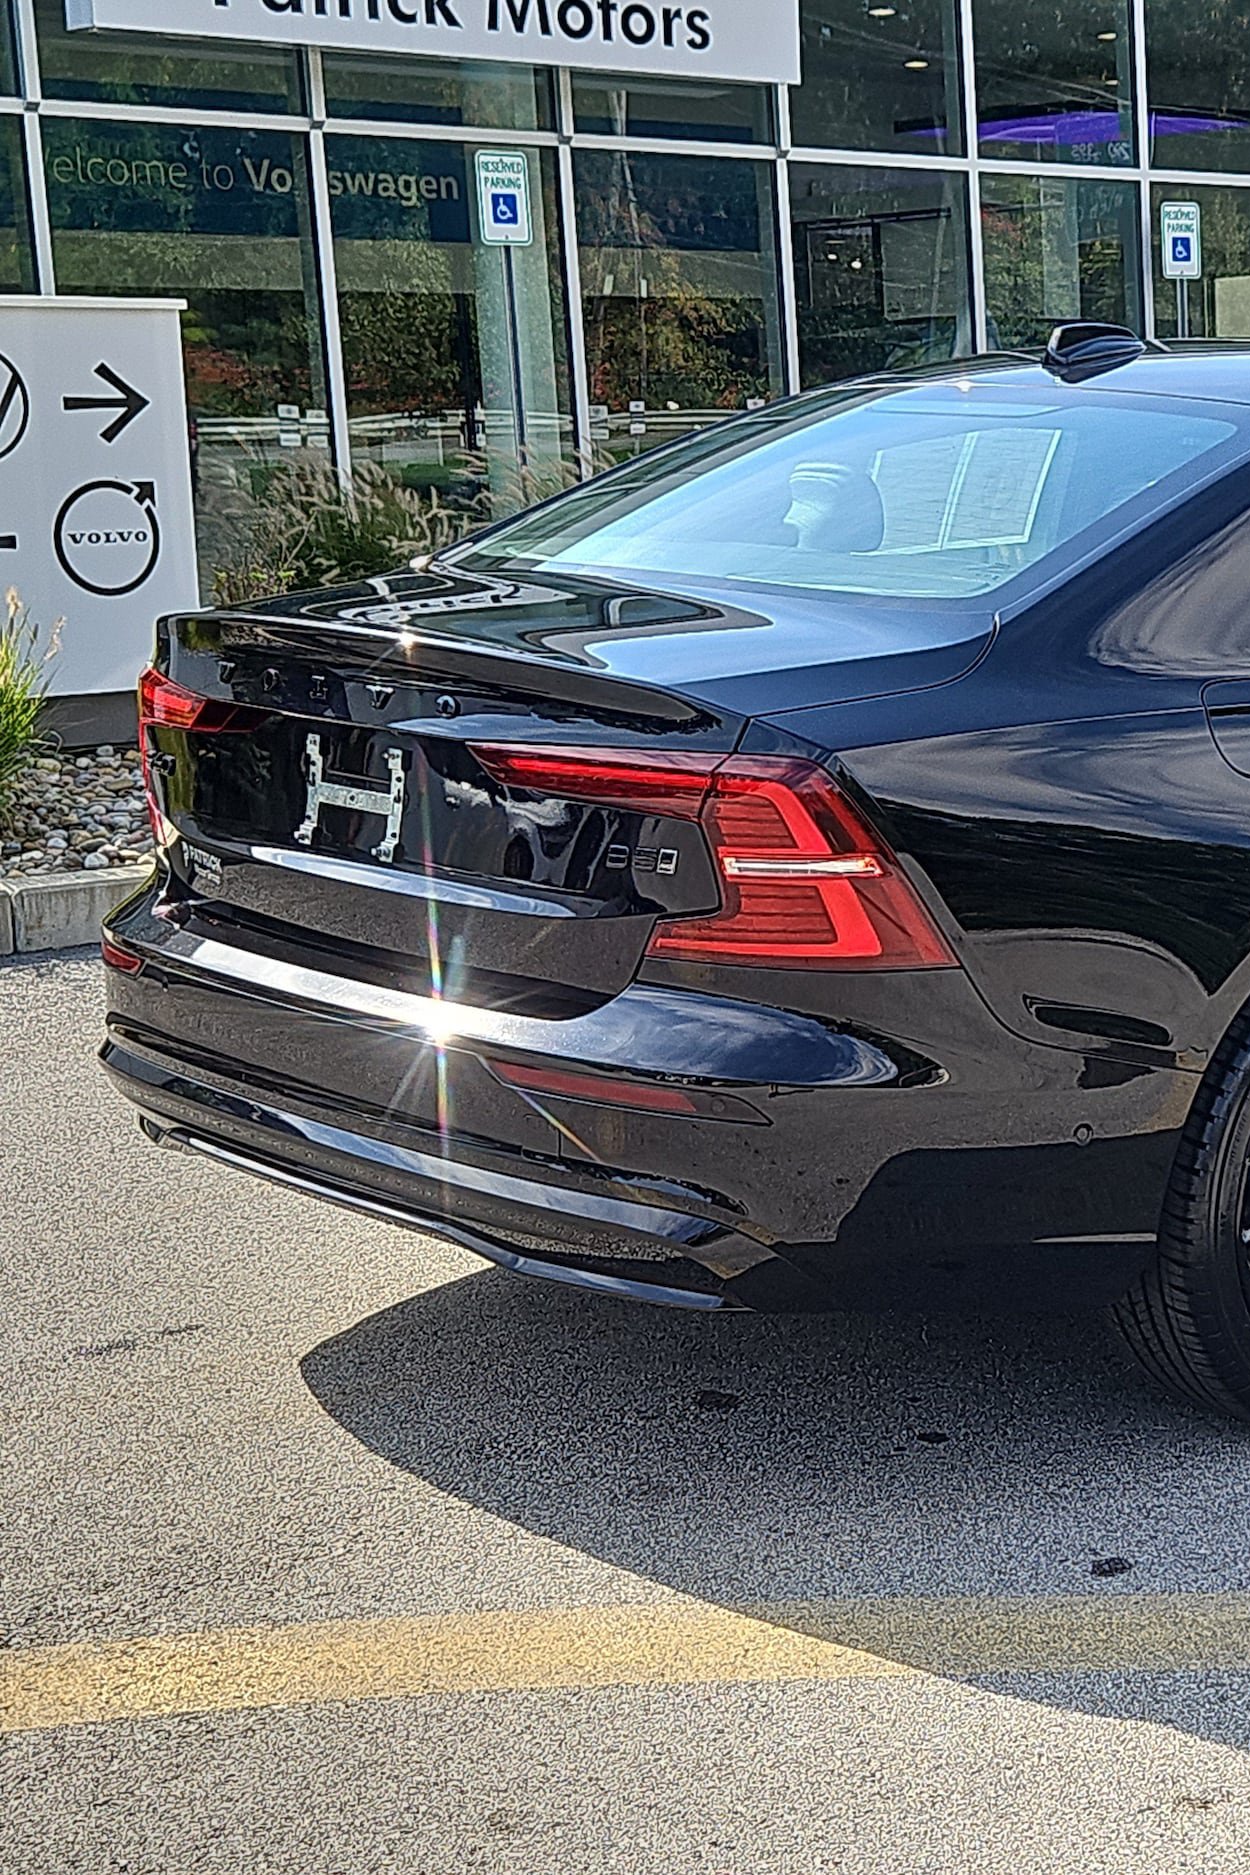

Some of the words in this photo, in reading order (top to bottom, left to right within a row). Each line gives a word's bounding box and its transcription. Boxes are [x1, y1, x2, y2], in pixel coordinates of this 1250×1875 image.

[487, 0, 711, 50] Motors
[481, 160, 523, 174] RESERVED
[45, 146, 189, 189] elcome
[200, 159, 234, 191] to
[243, 158, 459, 207] Voswagen
[483, 176, 522, 190] PARKING
[1164, 209, 1196, 221] RESERVED
[1167, 222, 1195, 233] PARKING
[67, 530, 148, 545] VOLVO
